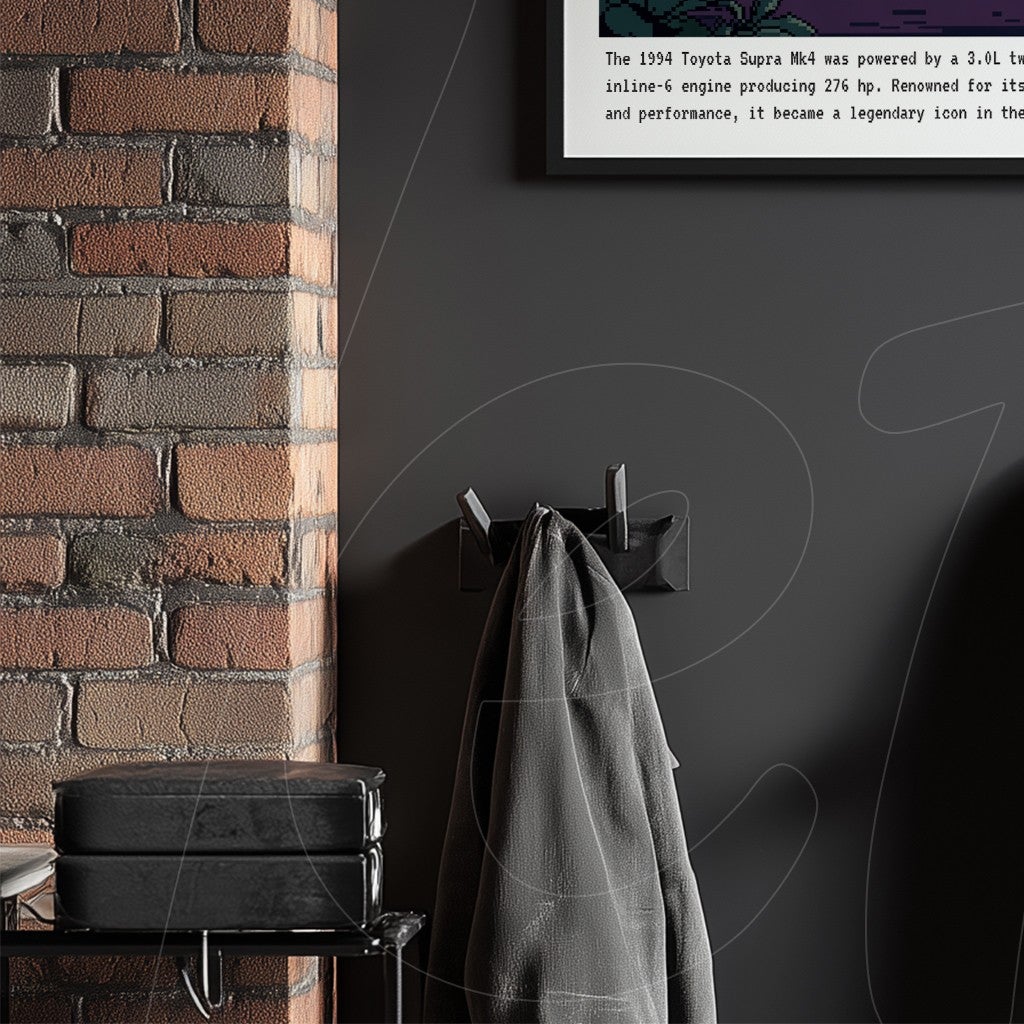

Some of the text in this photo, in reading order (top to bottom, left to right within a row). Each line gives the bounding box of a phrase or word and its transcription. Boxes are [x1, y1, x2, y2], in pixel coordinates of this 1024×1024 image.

[605, 51, 631, 66] The
[639, 51, 673, 66] 1994
[681, 51, 732, 69] Toyota
[740, 51, 782, 69] Supra
[790, 51, 816, 66] Mk4
[824, 54, 849, 66] was
[857, 50, 917, 69] powered
[924, 50, 942, 69] by
[950, 54, 959, 66] a
[967, 50, 1001, 66] 3.0L
[605, 78, 673, 93] inline-6
[681, 78, 732, 97] engine
[740, 78, 816, 97] producing
[824, 78, 849, 93] 276
[857, 78, 881, 97] hp.
[891, 78, 959, 93] Renowned
[968, 78, 993, 93] for
[605, 106, 631, 120] and
[638, 106, 738, 124] performance,
[749, 106, 765, 120] it
[773, 106, 824, 120] became
[832, 109, 841, 120] a
[850, 105, 925, 124] legendary
[934, 105, 968, 120] icon
[976, 105, 993, 120] in
